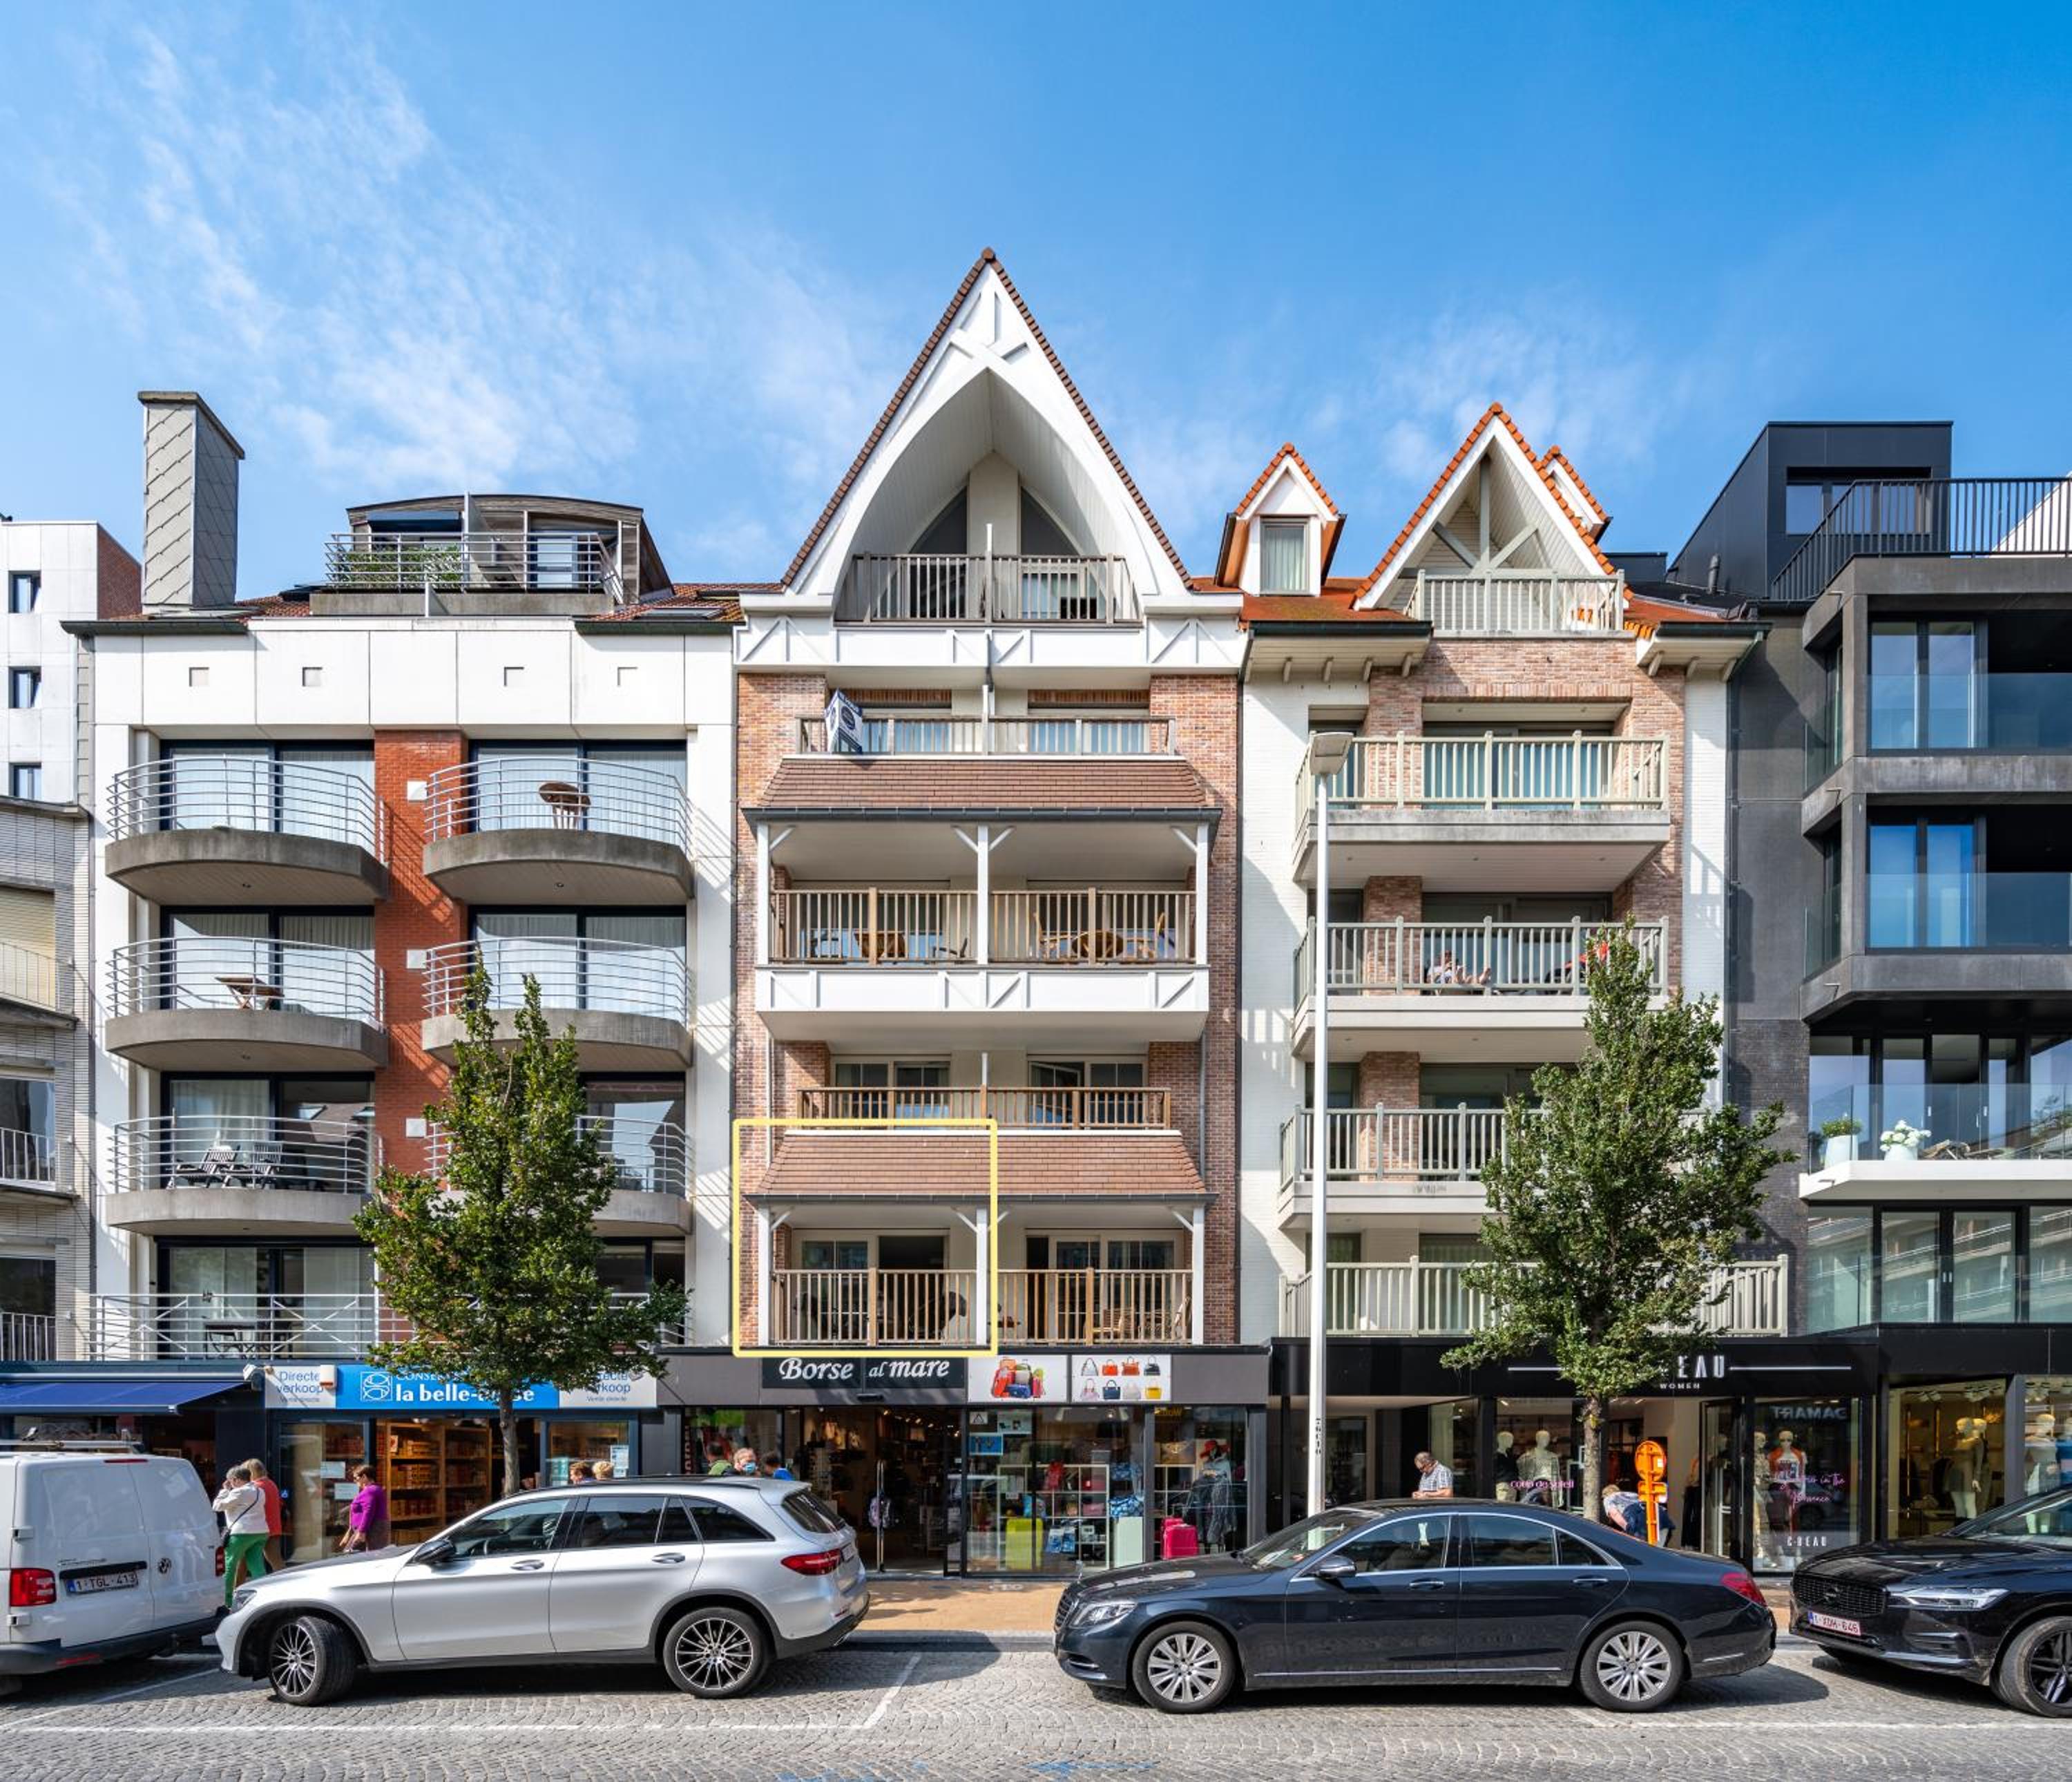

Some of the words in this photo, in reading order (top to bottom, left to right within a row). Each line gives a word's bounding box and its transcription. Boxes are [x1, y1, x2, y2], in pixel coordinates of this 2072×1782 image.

[778, 1358, 854, 1380] Borse
[868, 1361, 885, 1378] al
[888, 1359, 950, 1378] mare
[1678, 1355, 1725, 1378] EAU
[278, 1383, 324, 1395] verkoop
[396, 1384, 414, 1401] la
[420, 1384, 535, 1401] belle-se
